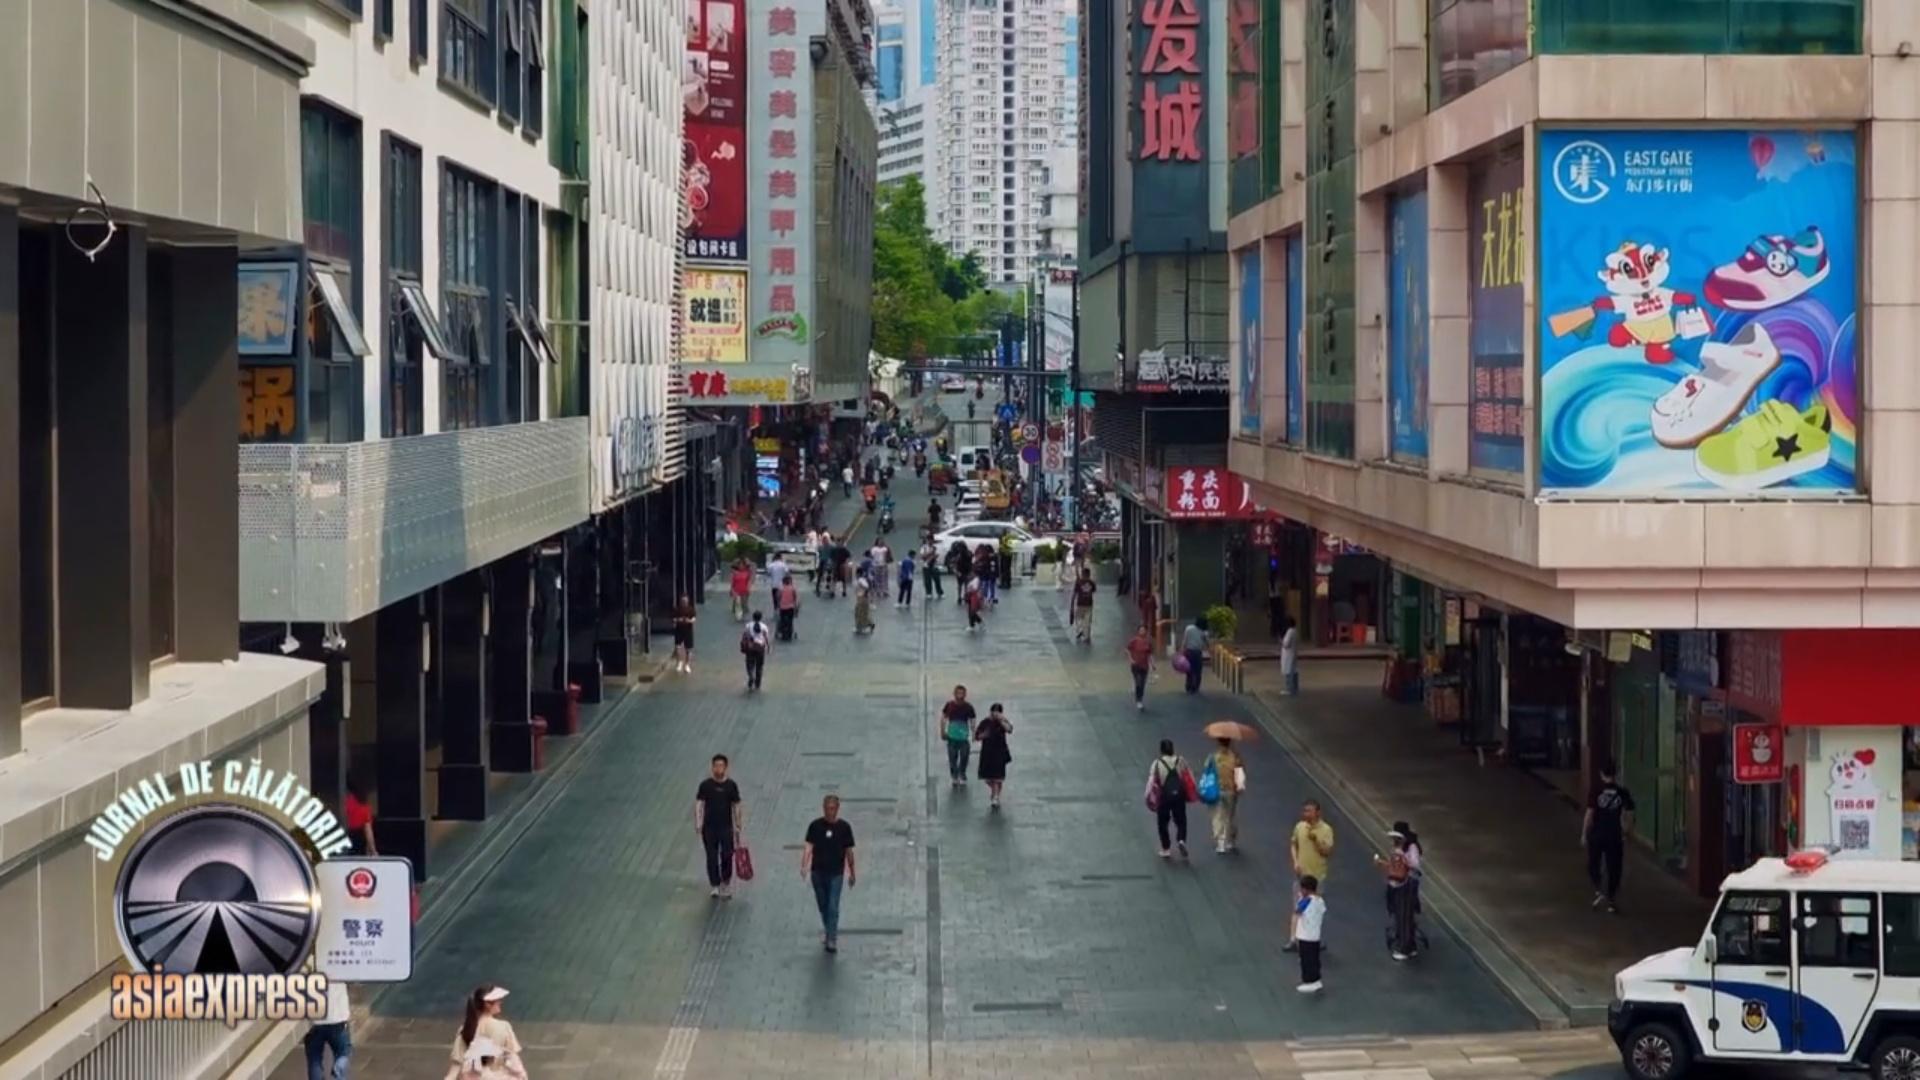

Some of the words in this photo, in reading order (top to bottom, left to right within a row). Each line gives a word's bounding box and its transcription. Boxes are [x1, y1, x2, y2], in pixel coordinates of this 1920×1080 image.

[1141, 0, 1202, 161] 发城
[1624, 150, 1659, 166] EAST
[1660, 150, 1693, 166] GATE
[1625, 178, 1693, 193] 东门步行街
[342, 919, 384, 939] 警察
